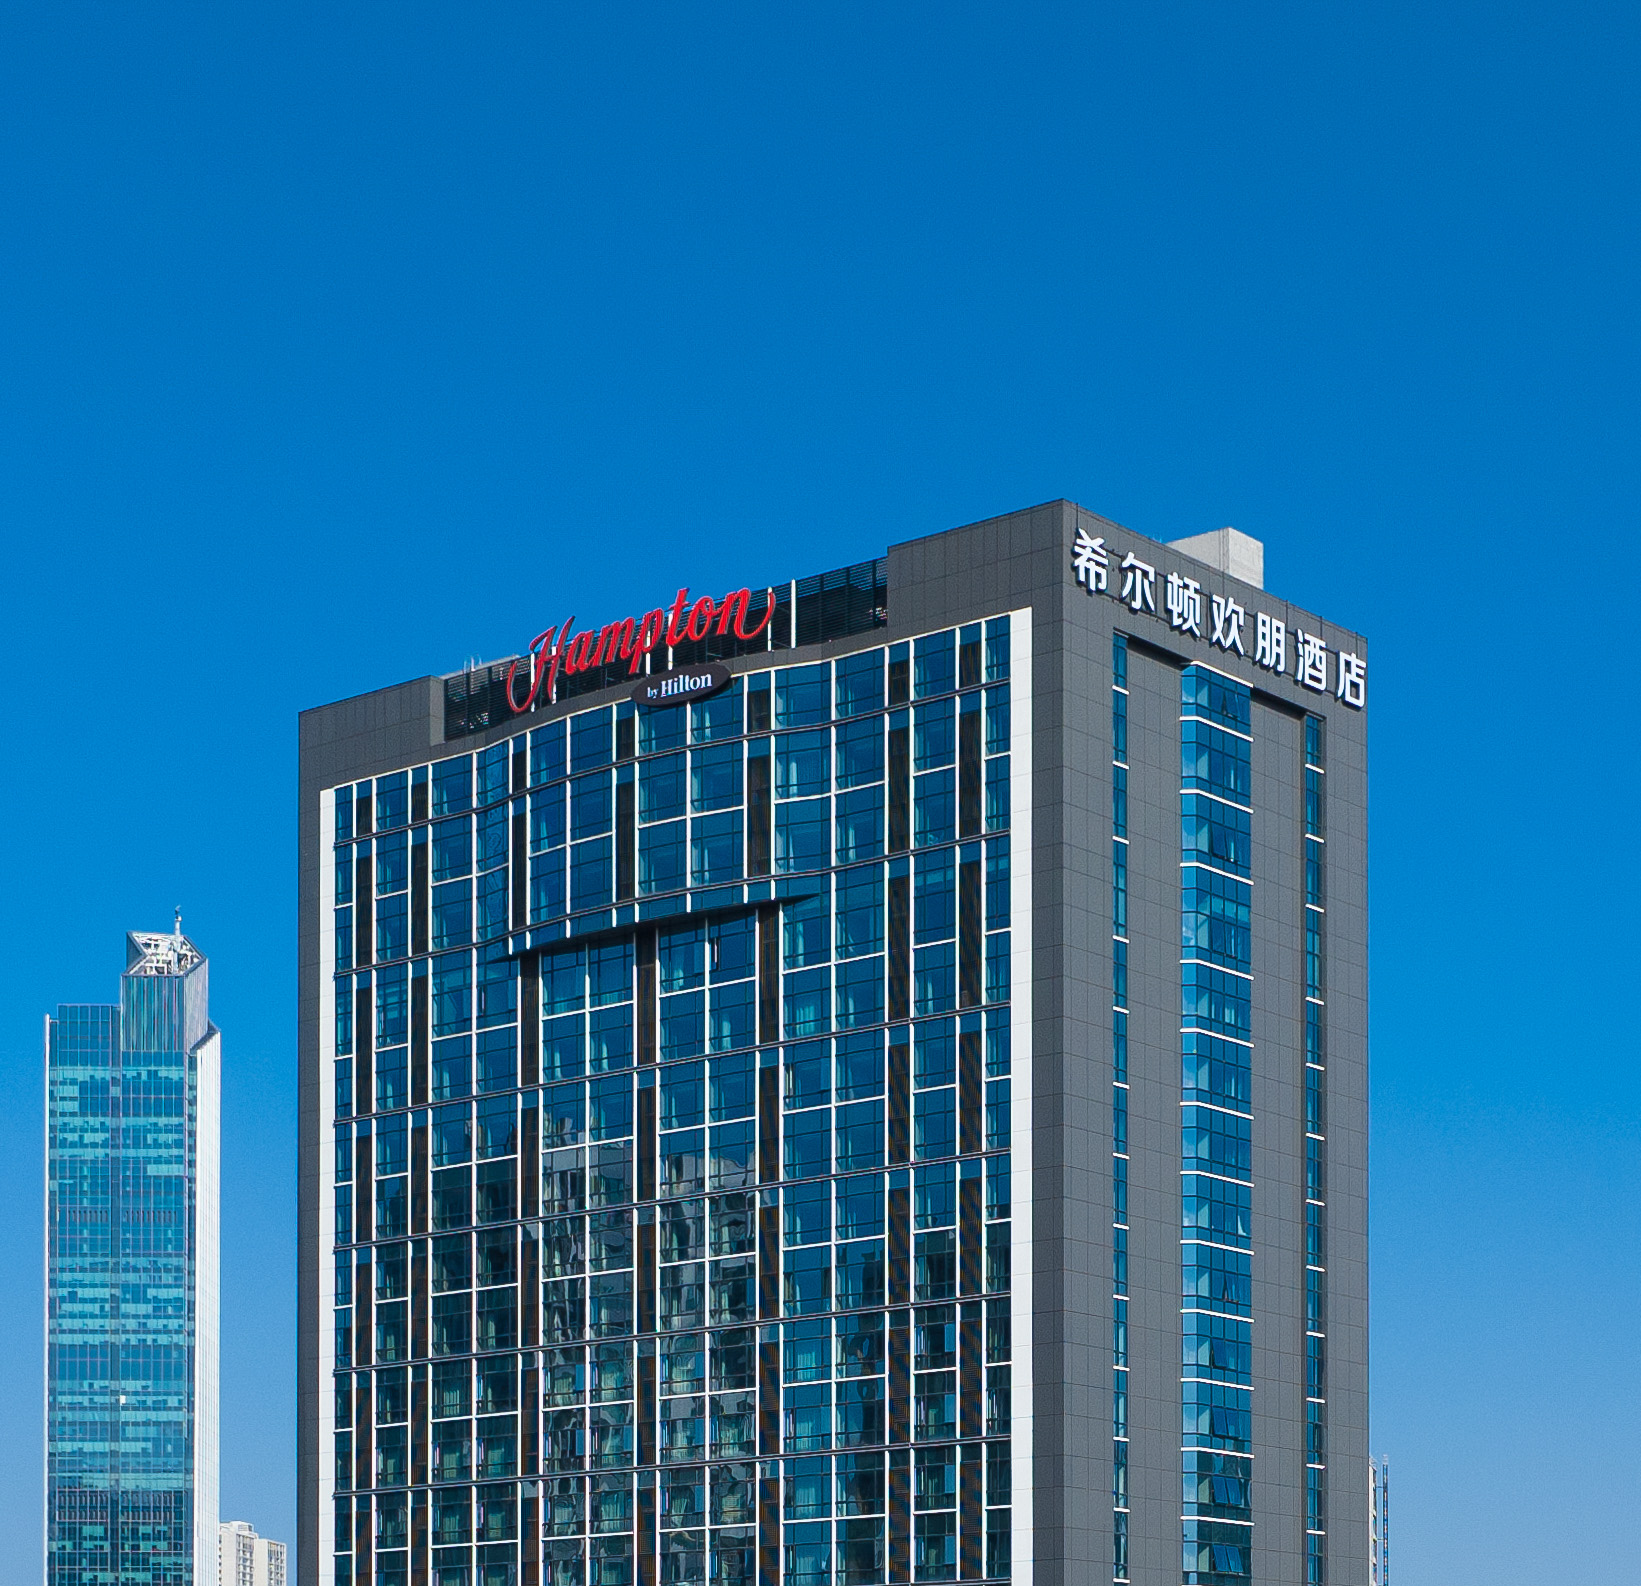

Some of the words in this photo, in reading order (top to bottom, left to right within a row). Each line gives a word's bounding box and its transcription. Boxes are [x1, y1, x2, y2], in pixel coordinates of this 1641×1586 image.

[506, 587, 776, 713] Hampton
[1073, 527, 1368, 708] 希尔顿欢朋酒店
[646, 686, 660, 700] by
[660, 672, 713, 698] Hilton
